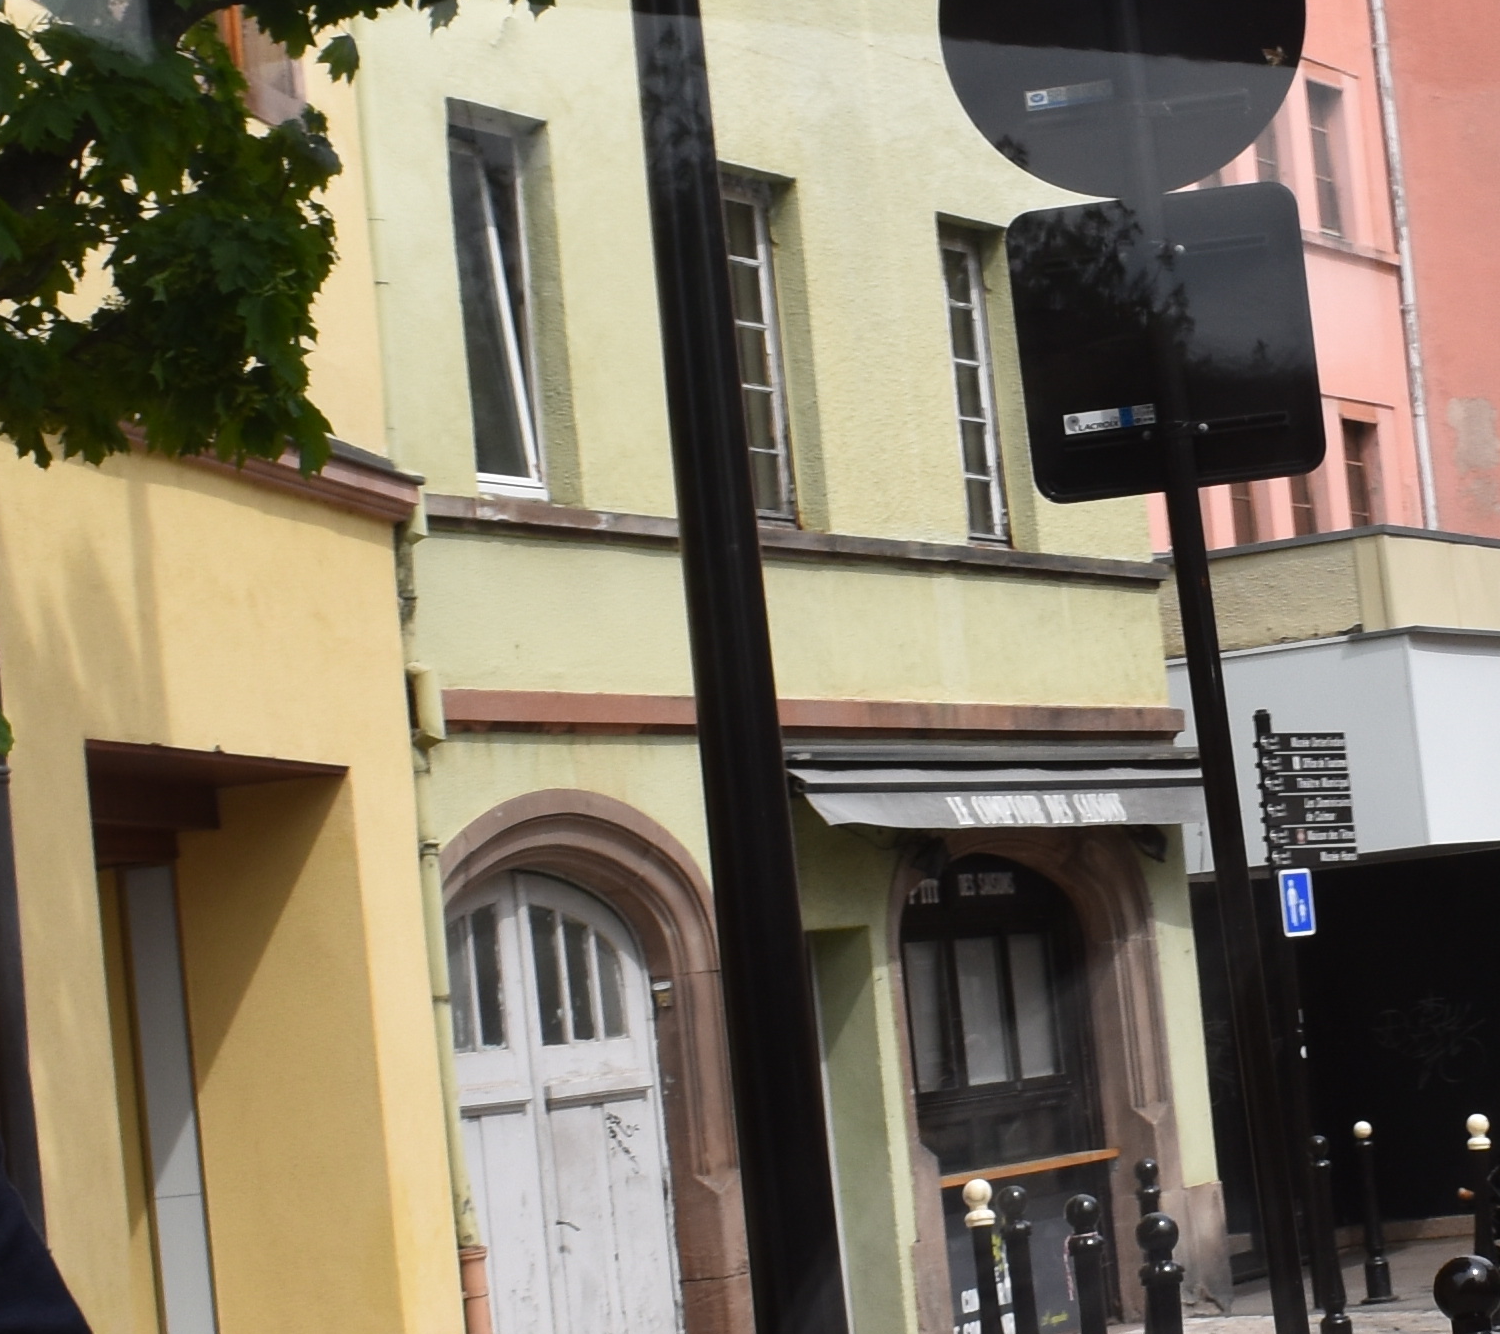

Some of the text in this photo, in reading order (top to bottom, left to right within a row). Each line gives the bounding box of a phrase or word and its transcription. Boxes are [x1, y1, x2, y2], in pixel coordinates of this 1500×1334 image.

[945, 792, 1128, 825] LE COMPTOIR DES SAISONS
